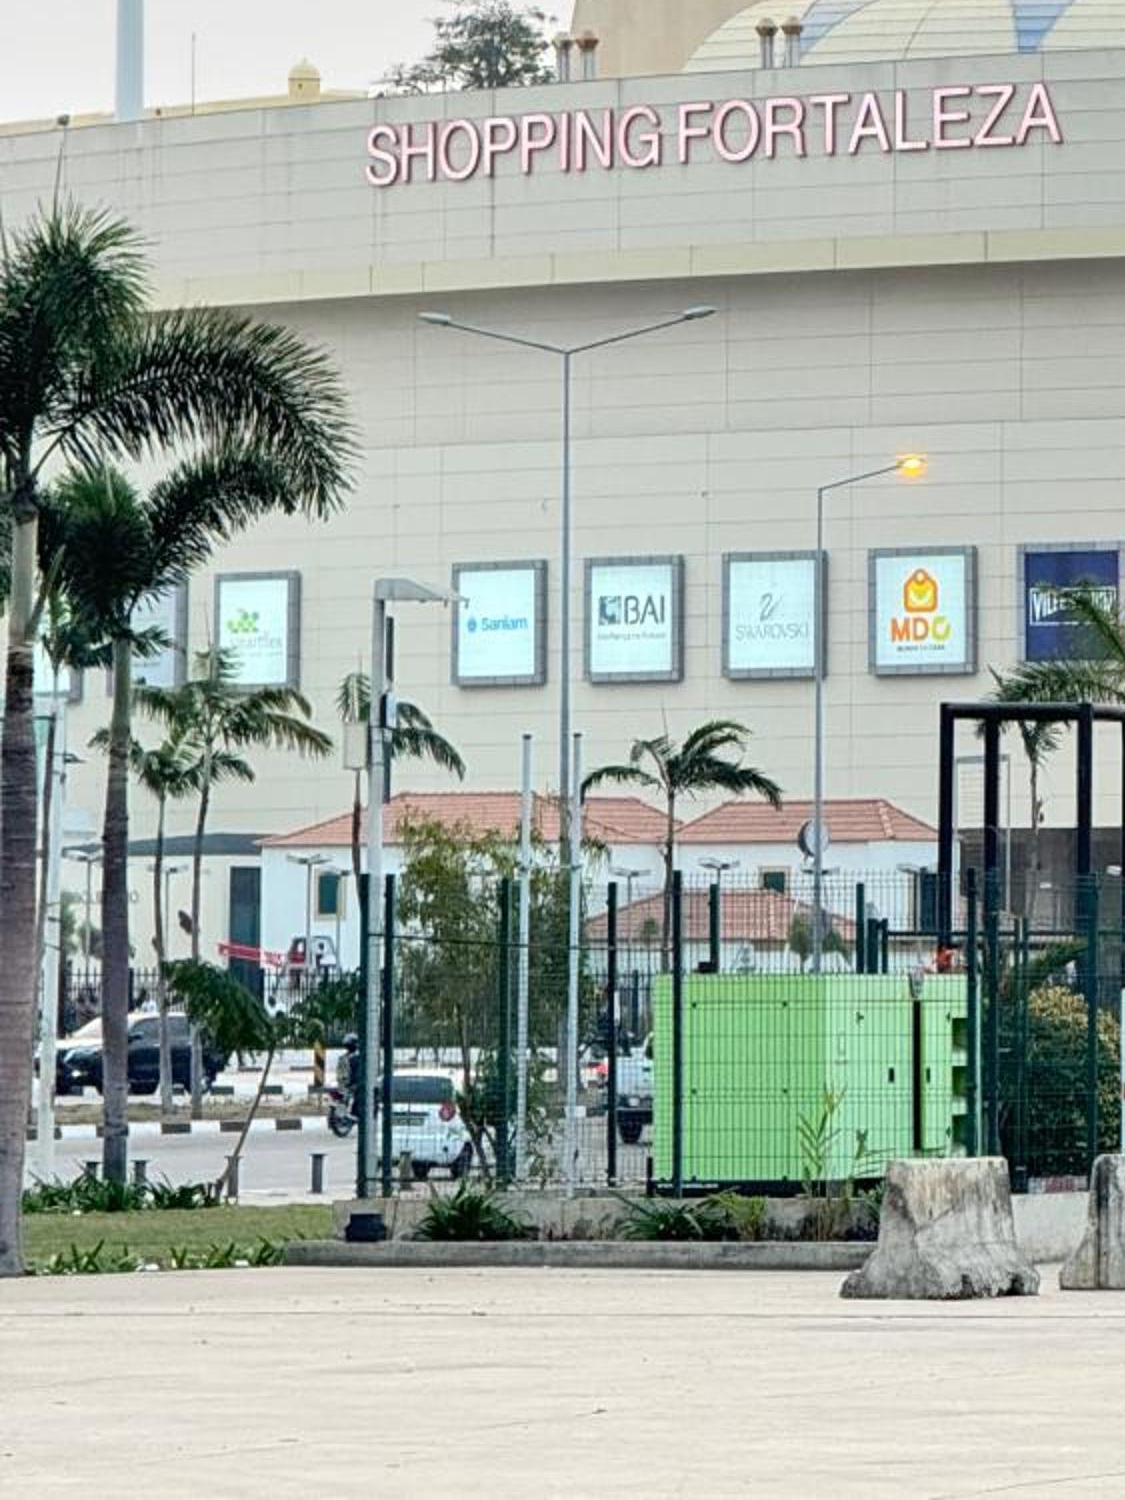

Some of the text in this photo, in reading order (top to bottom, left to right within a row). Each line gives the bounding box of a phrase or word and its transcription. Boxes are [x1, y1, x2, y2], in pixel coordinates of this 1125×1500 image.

[365, 82, 1063, 188] SHOPPING FORTALEZA
[624, 595, 665, 624] BAI
